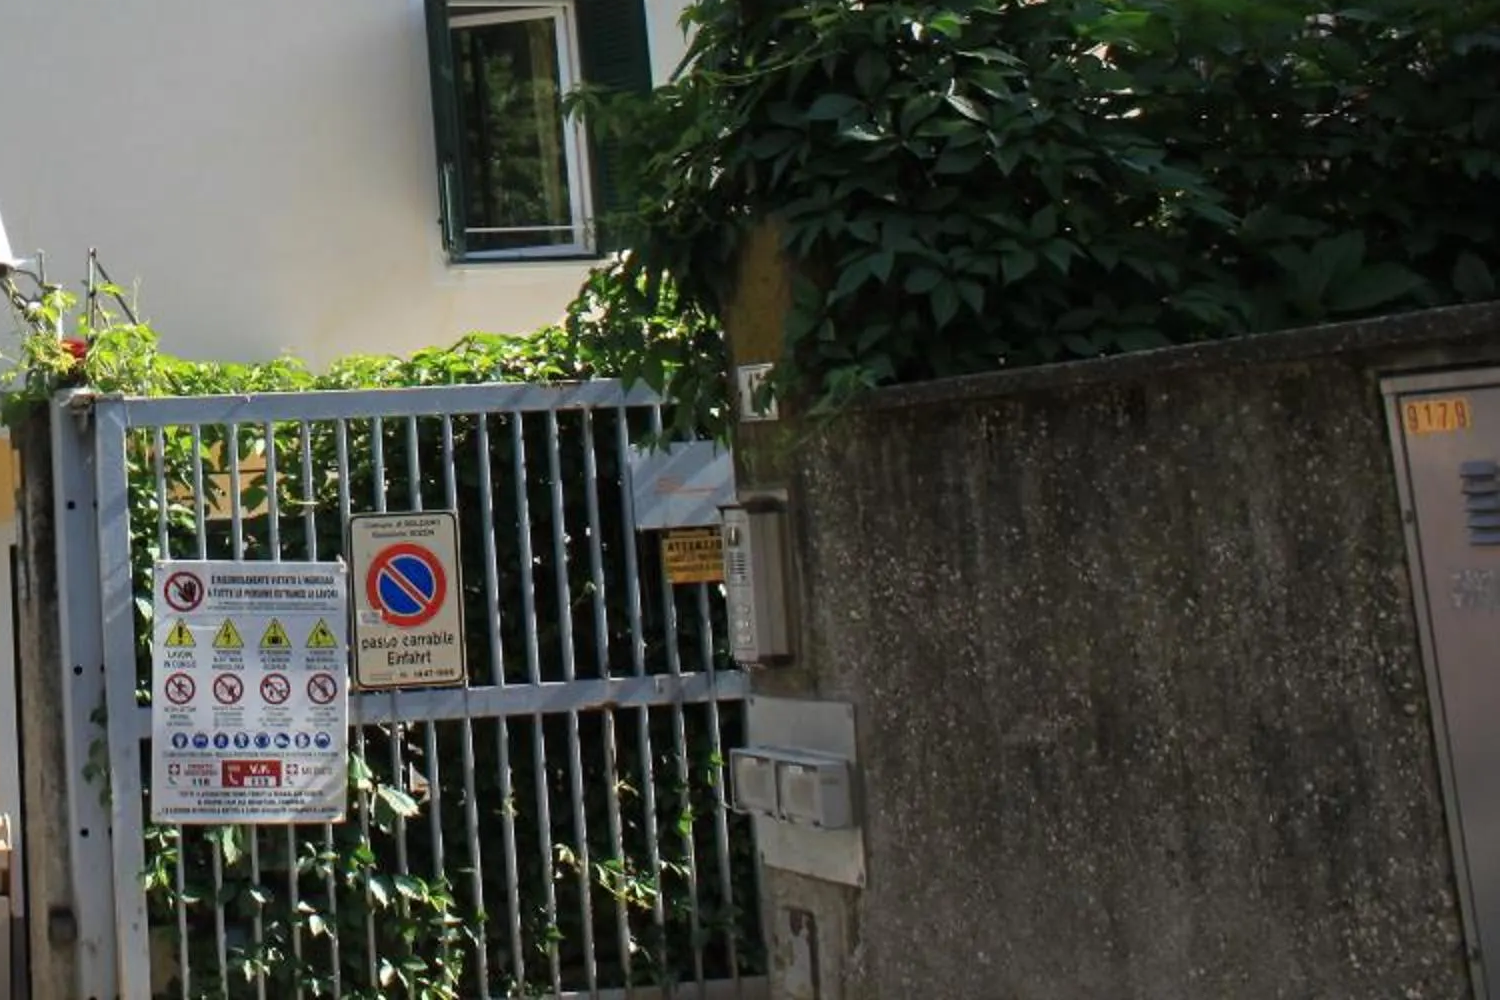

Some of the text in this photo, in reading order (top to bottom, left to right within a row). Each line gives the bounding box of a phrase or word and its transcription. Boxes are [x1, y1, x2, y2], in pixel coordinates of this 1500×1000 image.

[361, 631, 454, 650] passo carrabile
[387, 650, 431, 665] Einfahrt
